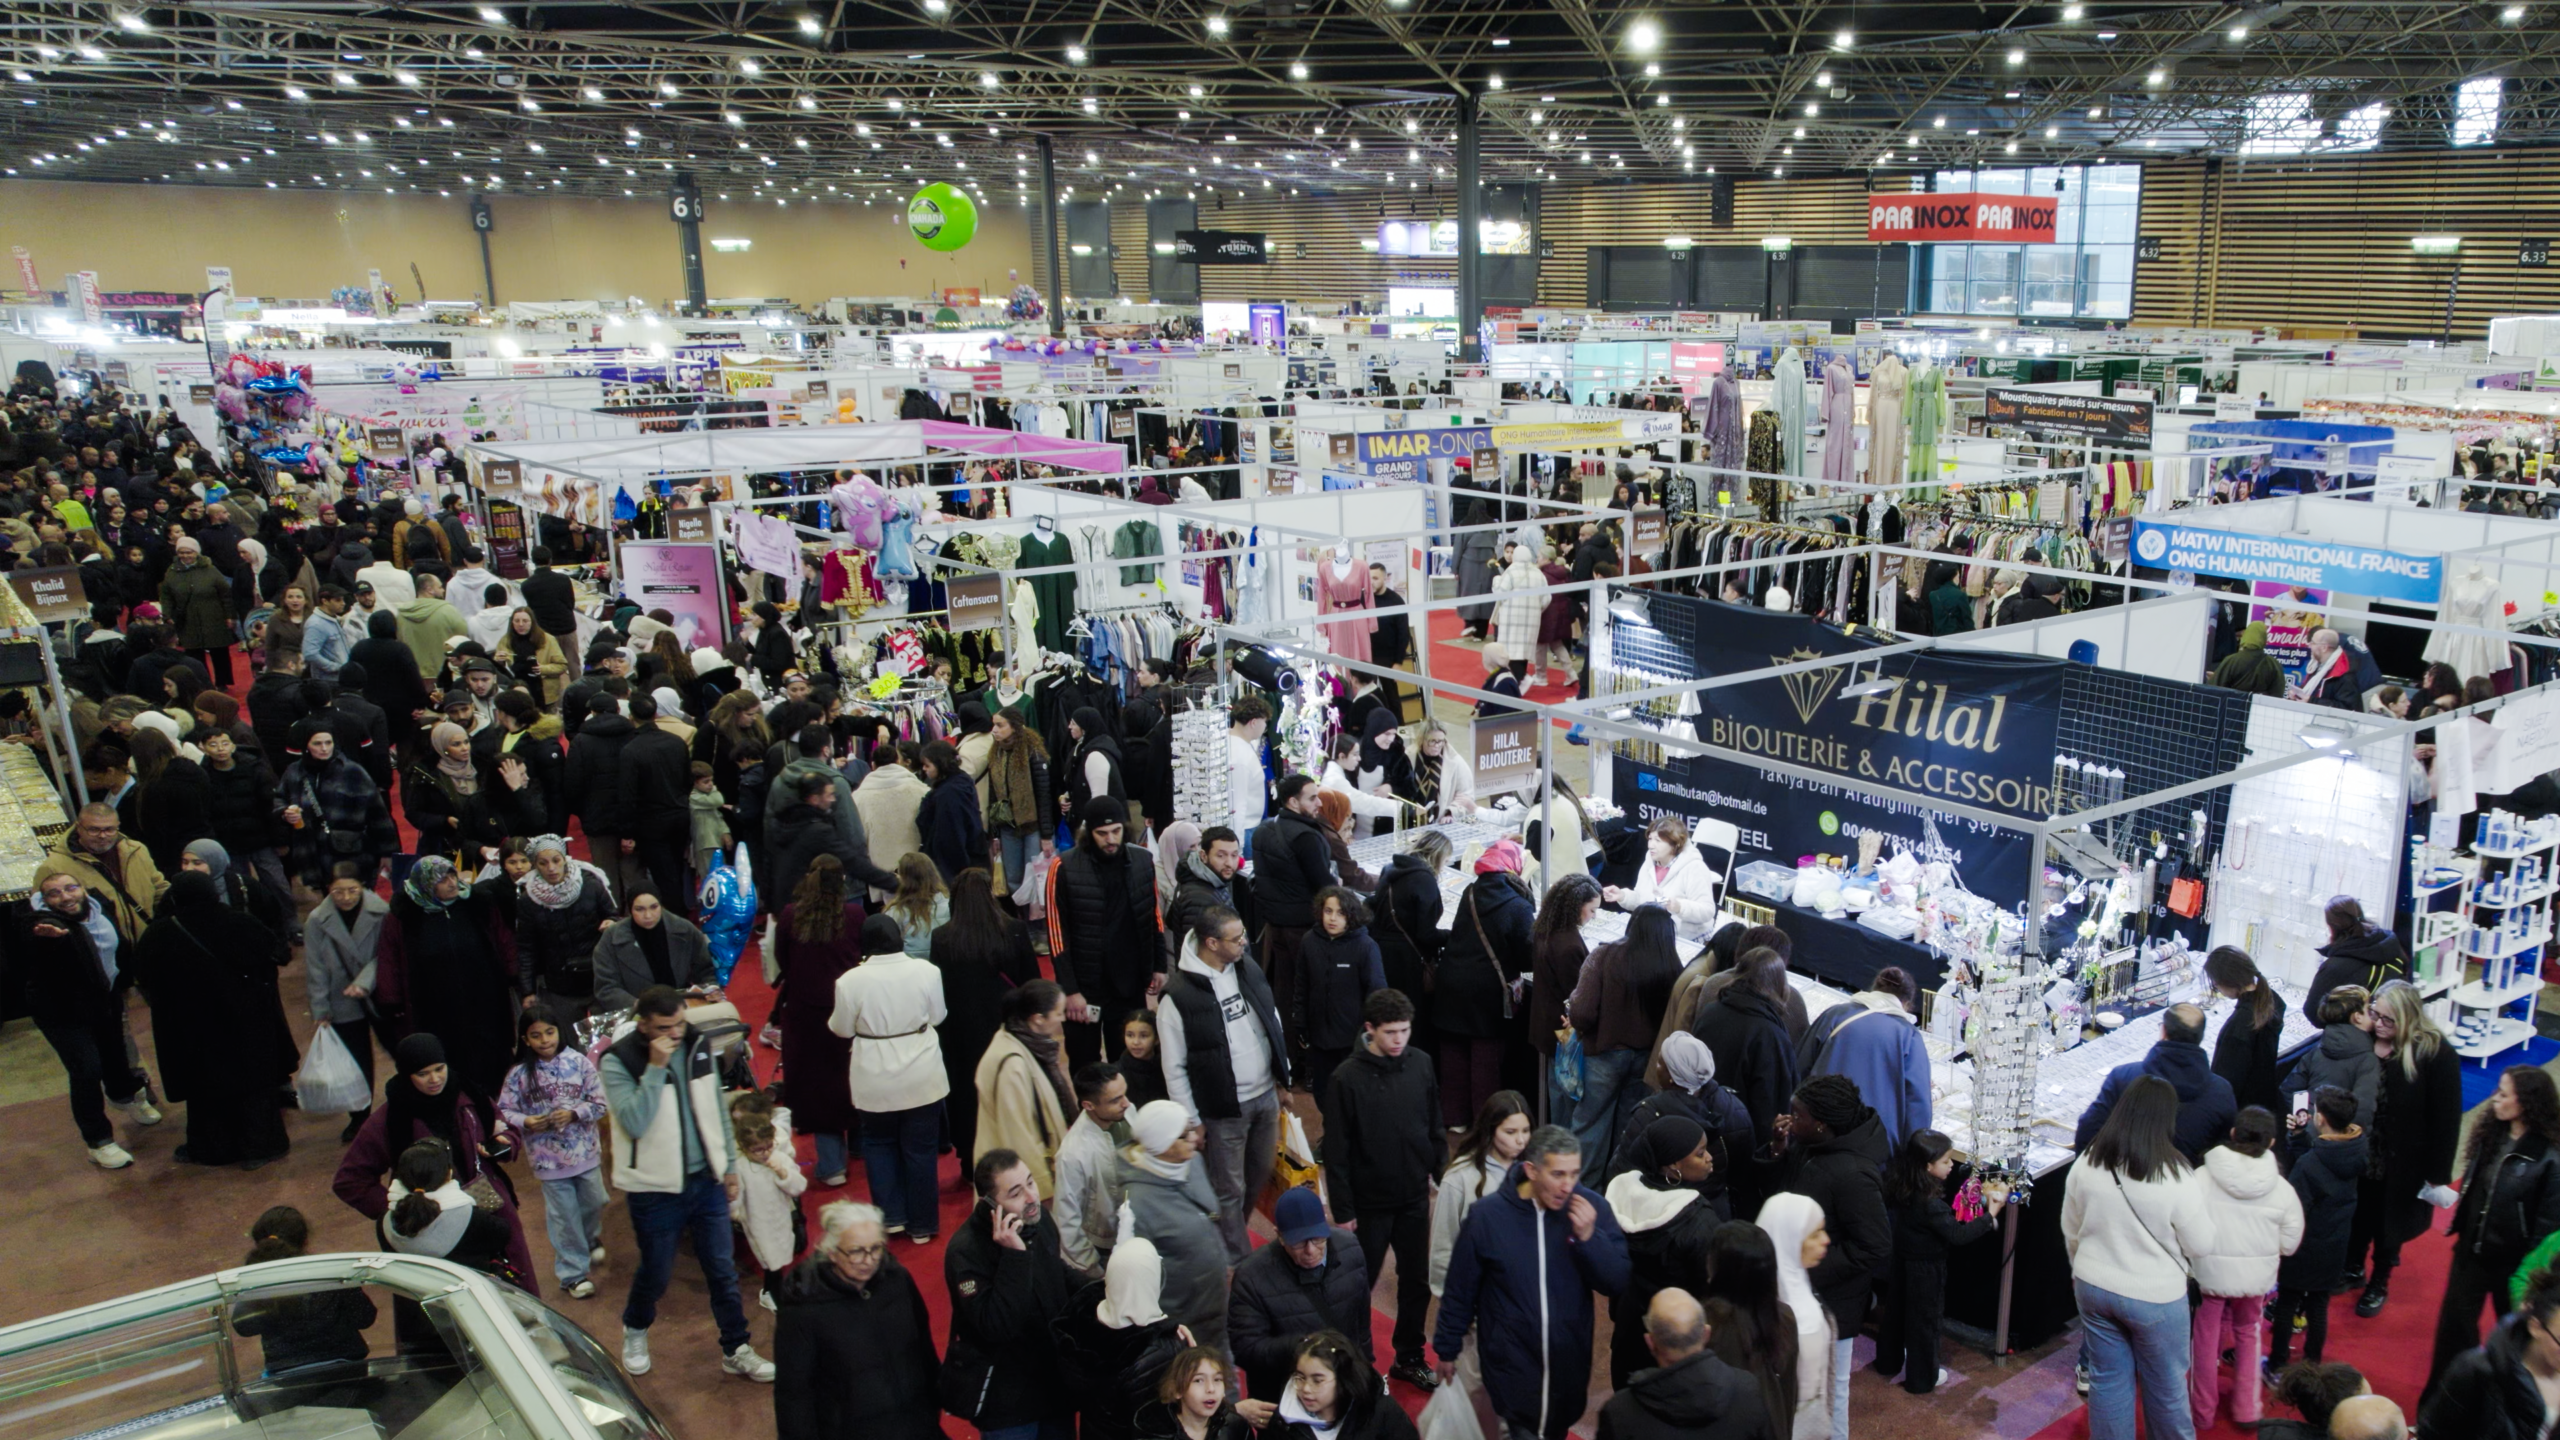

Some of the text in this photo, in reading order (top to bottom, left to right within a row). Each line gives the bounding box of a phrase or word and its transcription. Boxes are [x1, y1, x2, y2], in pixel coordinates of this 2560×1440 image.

[673, 197, 688, 218] 6
[693, 197, 702, 218] 6
[476, 211, 488, 228] 6
[1871, 205, 1970, 230] PARINOX
[1976, 204, 2055, 231] PARINOX
[1671, 251, 1686, 260] 6.29
[1772, 251, 1787, 261] 6.30
[2139, 248, 2159, 259] 6.32
[2521, 251, 2547, 263] 6.33
[208, 269, 230, 277] Nella
[291, 312, 320, 321] Nella
[1999, 391, 2136, 413] Moustiquaires plissés sur-mesure
[2023, 405, 2067, 417] Fabrication
[2067, 410, 2078, 419] en
[2079, 410, 2084, 419] 7
[2085, 411, 2107, 422] jours
[1500, 430, 1518, 440] ONG
[1520, 428, 1566, 438] Humanitaire
[1652, 422, 1673, 433] IMAR
[1375, 461, 1412, 474] GRAND
[1375, 471, 1412, 481] CONCOURS
[678, 517, 702, 530] Nigella
[1637, 519, 1661, 533] L'épicerie
[678, 529, 704, 540] Repaire
[1637, 531, 1660, 541] orientale
[2171, 530, 2431, 580] MATW INTERNATIONAL FRANCE
[2168, 550, 2323, 585] ONG HUMANITAIRE
[31, 578, 66, 593] Khalid
[35, 592, 69, 606] Bijoux
[952, 593, 999, 609] Caftansucre
[2290, 649, 2308, 658] plus
[1851, 669, 2009, 754] Hilal
[1493, 731, 1520, 751] HILAL
[1479, 747, 1533, 771] BIJOUTERIE
[1858, 748, 1880, 779] &
[1524, 772, 1535, 785] 77
[1657, 778, 1768, 816] kamilbutan@hotmail.de
